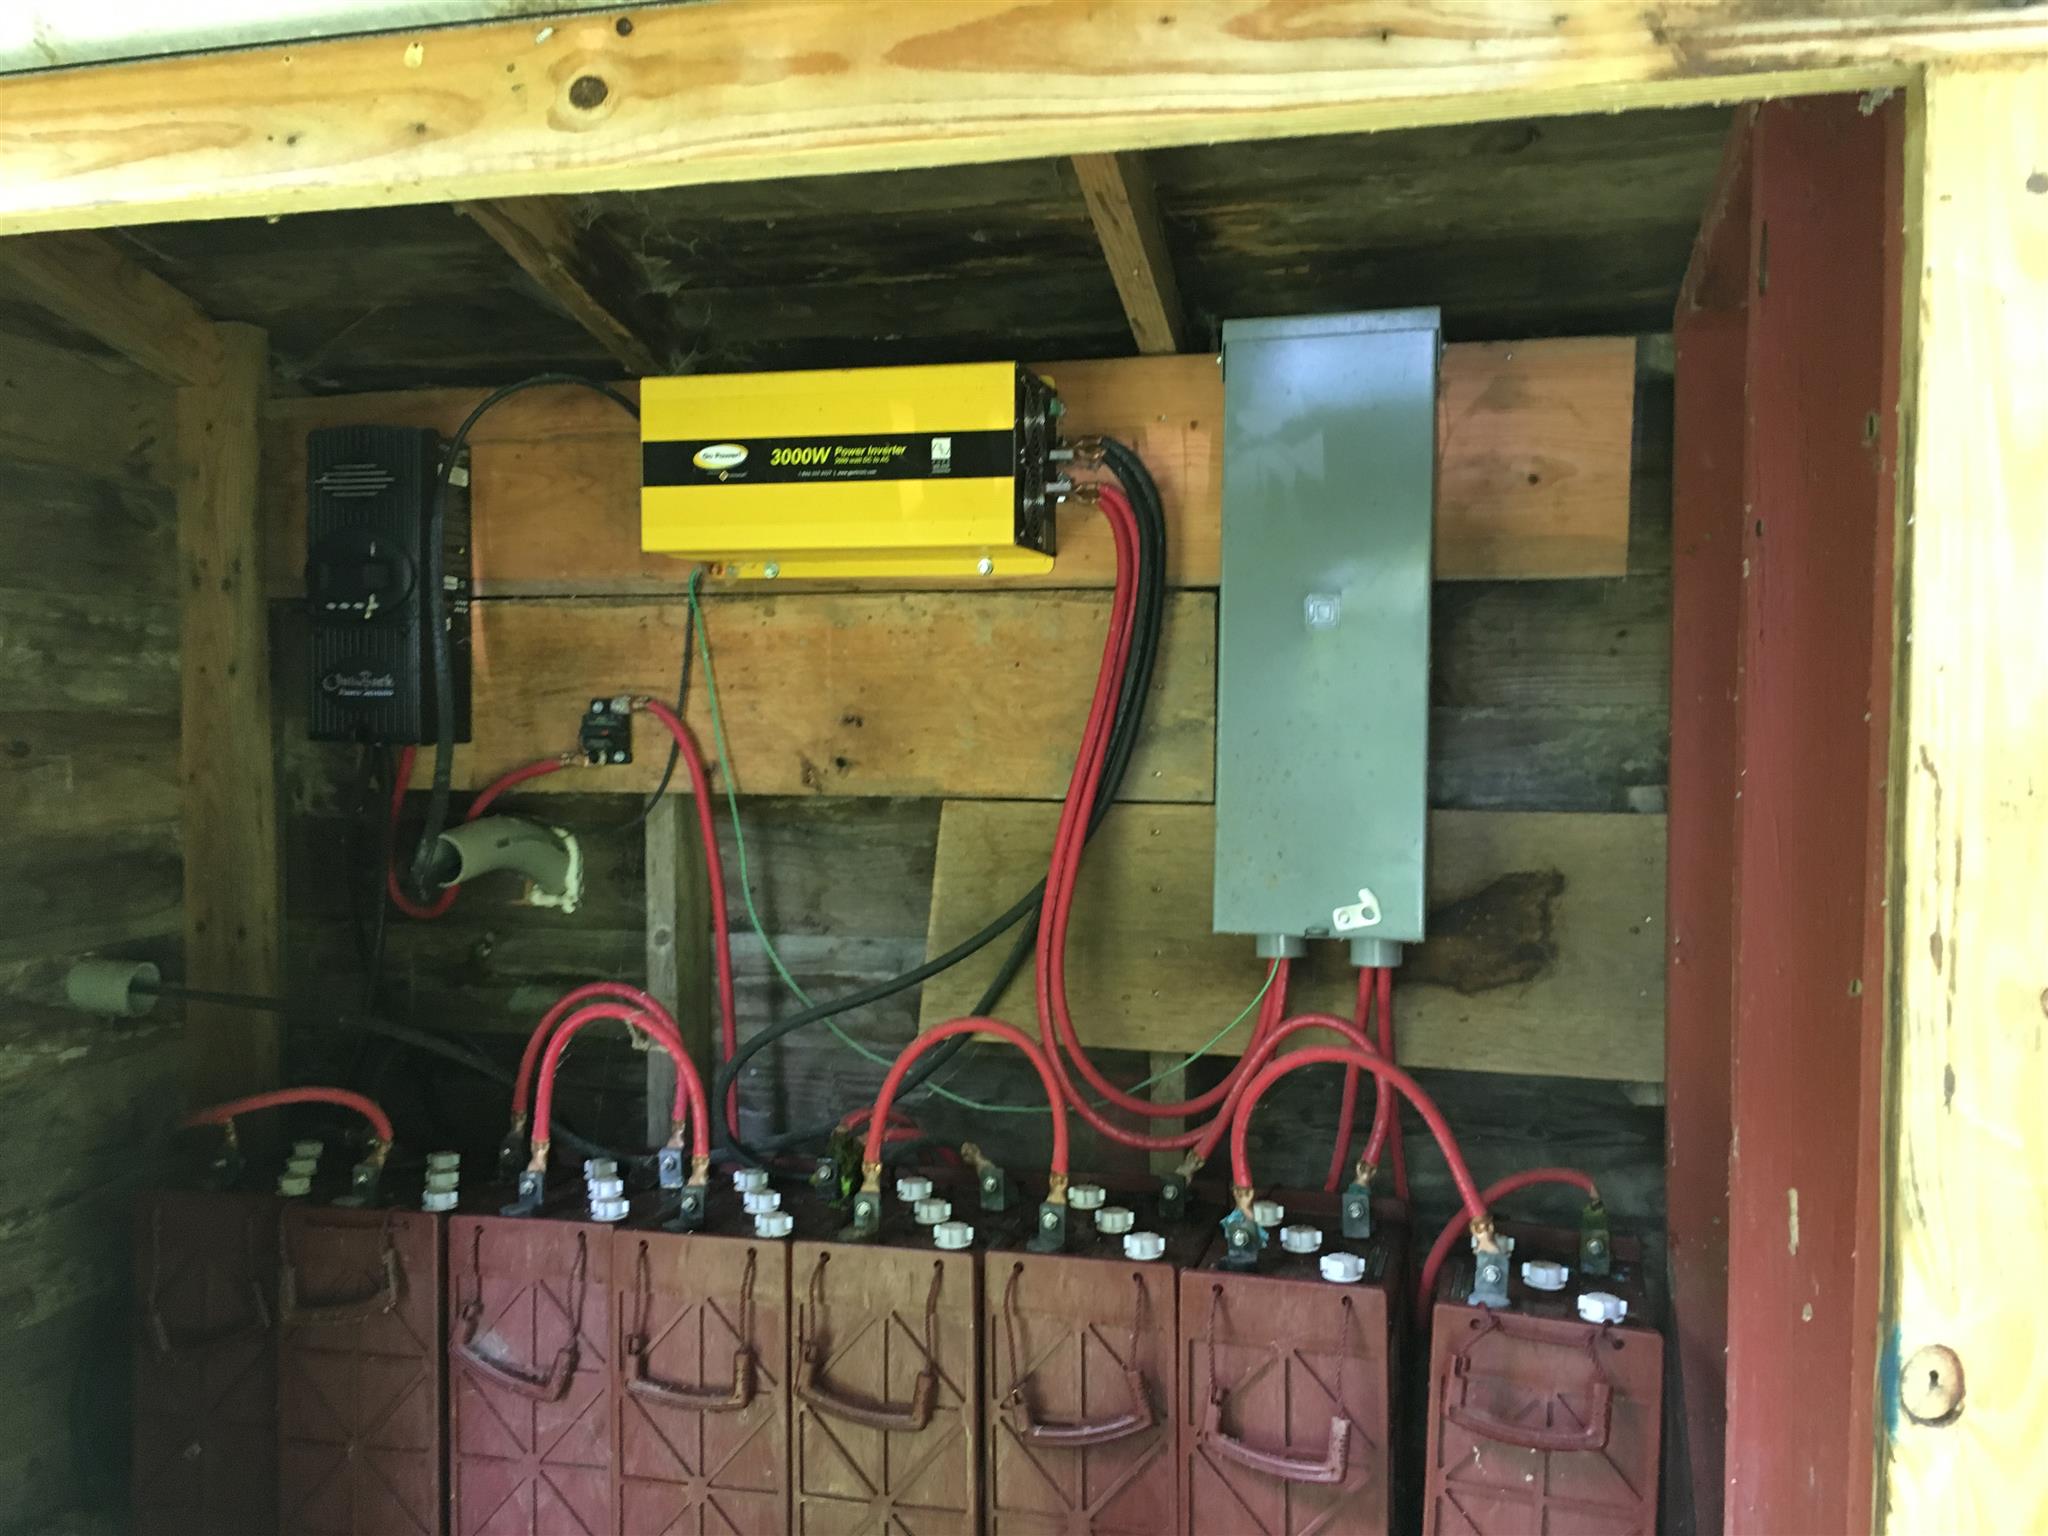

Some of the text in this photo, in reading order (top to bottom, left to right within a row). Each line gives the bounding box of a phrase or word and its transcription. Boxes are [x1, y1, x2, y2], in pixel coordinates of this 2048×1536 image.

[770, 446, 831, 466] 3000W
[834, 445, 907, 456] Power Inverter
